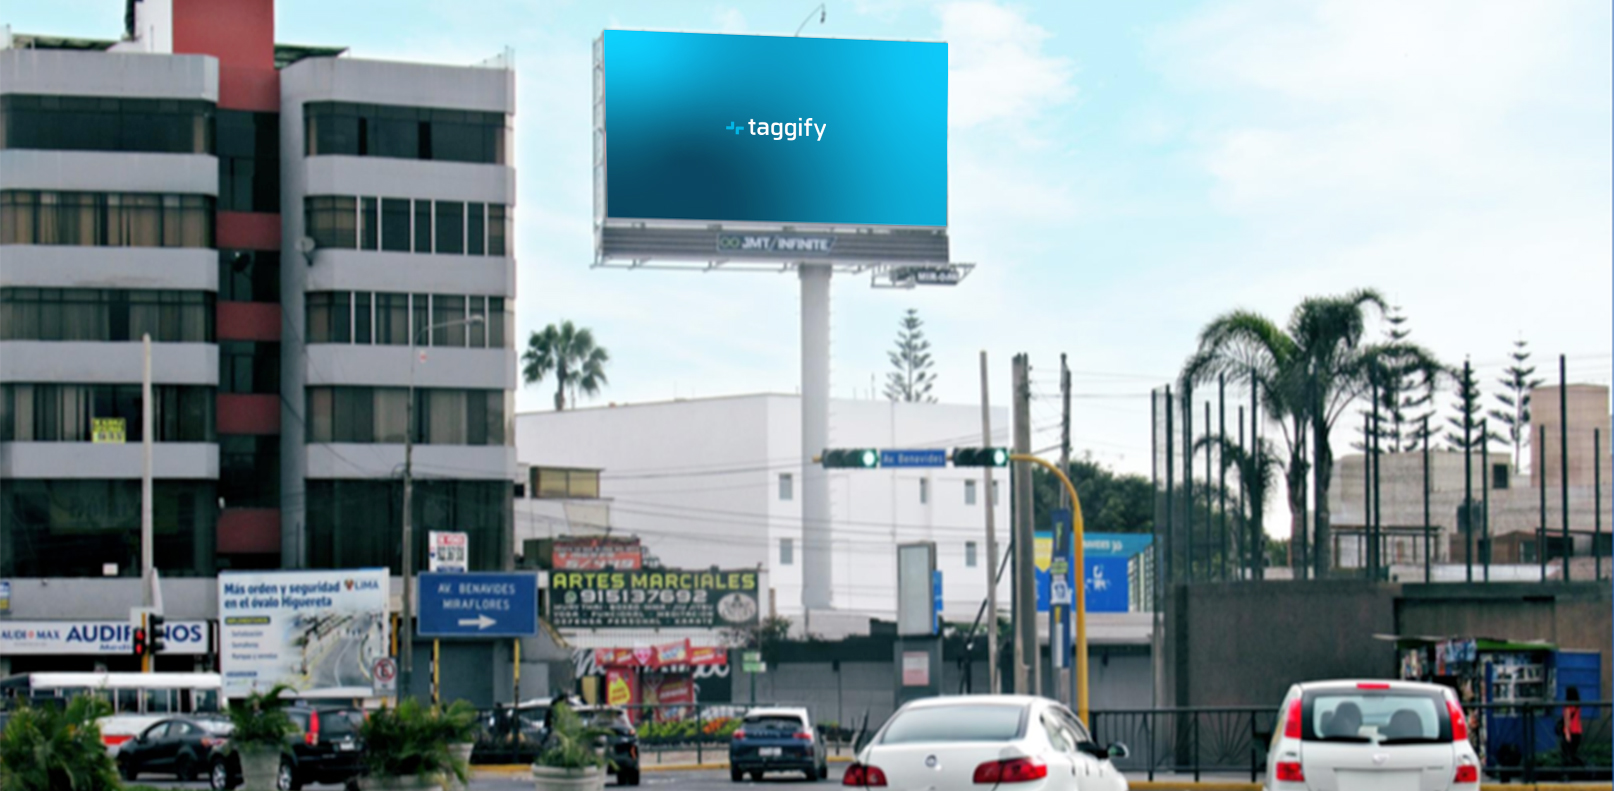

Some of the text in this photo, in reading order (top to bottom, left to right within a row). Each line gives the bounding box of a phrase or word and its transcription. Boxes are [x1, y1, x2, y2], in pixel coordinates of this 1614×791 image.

[748, 117, 827, 141] taggify
[553, 573, 756, 589] ARTES MARCIALES
[247, 583, 277, 594] orden
[280, 584, 287, 596] y
[289, 581, 340, 596] seguridad
[458, 583, 516, 595] BENAVIDES
[224, 600, 237, 608] en
[239, 597, 249, 608] el
[281, 596, 332, 610] Higuereta
[580, 589, 707, 603] 915137692
[442, 599, 510, 610] MIRAFLORES
